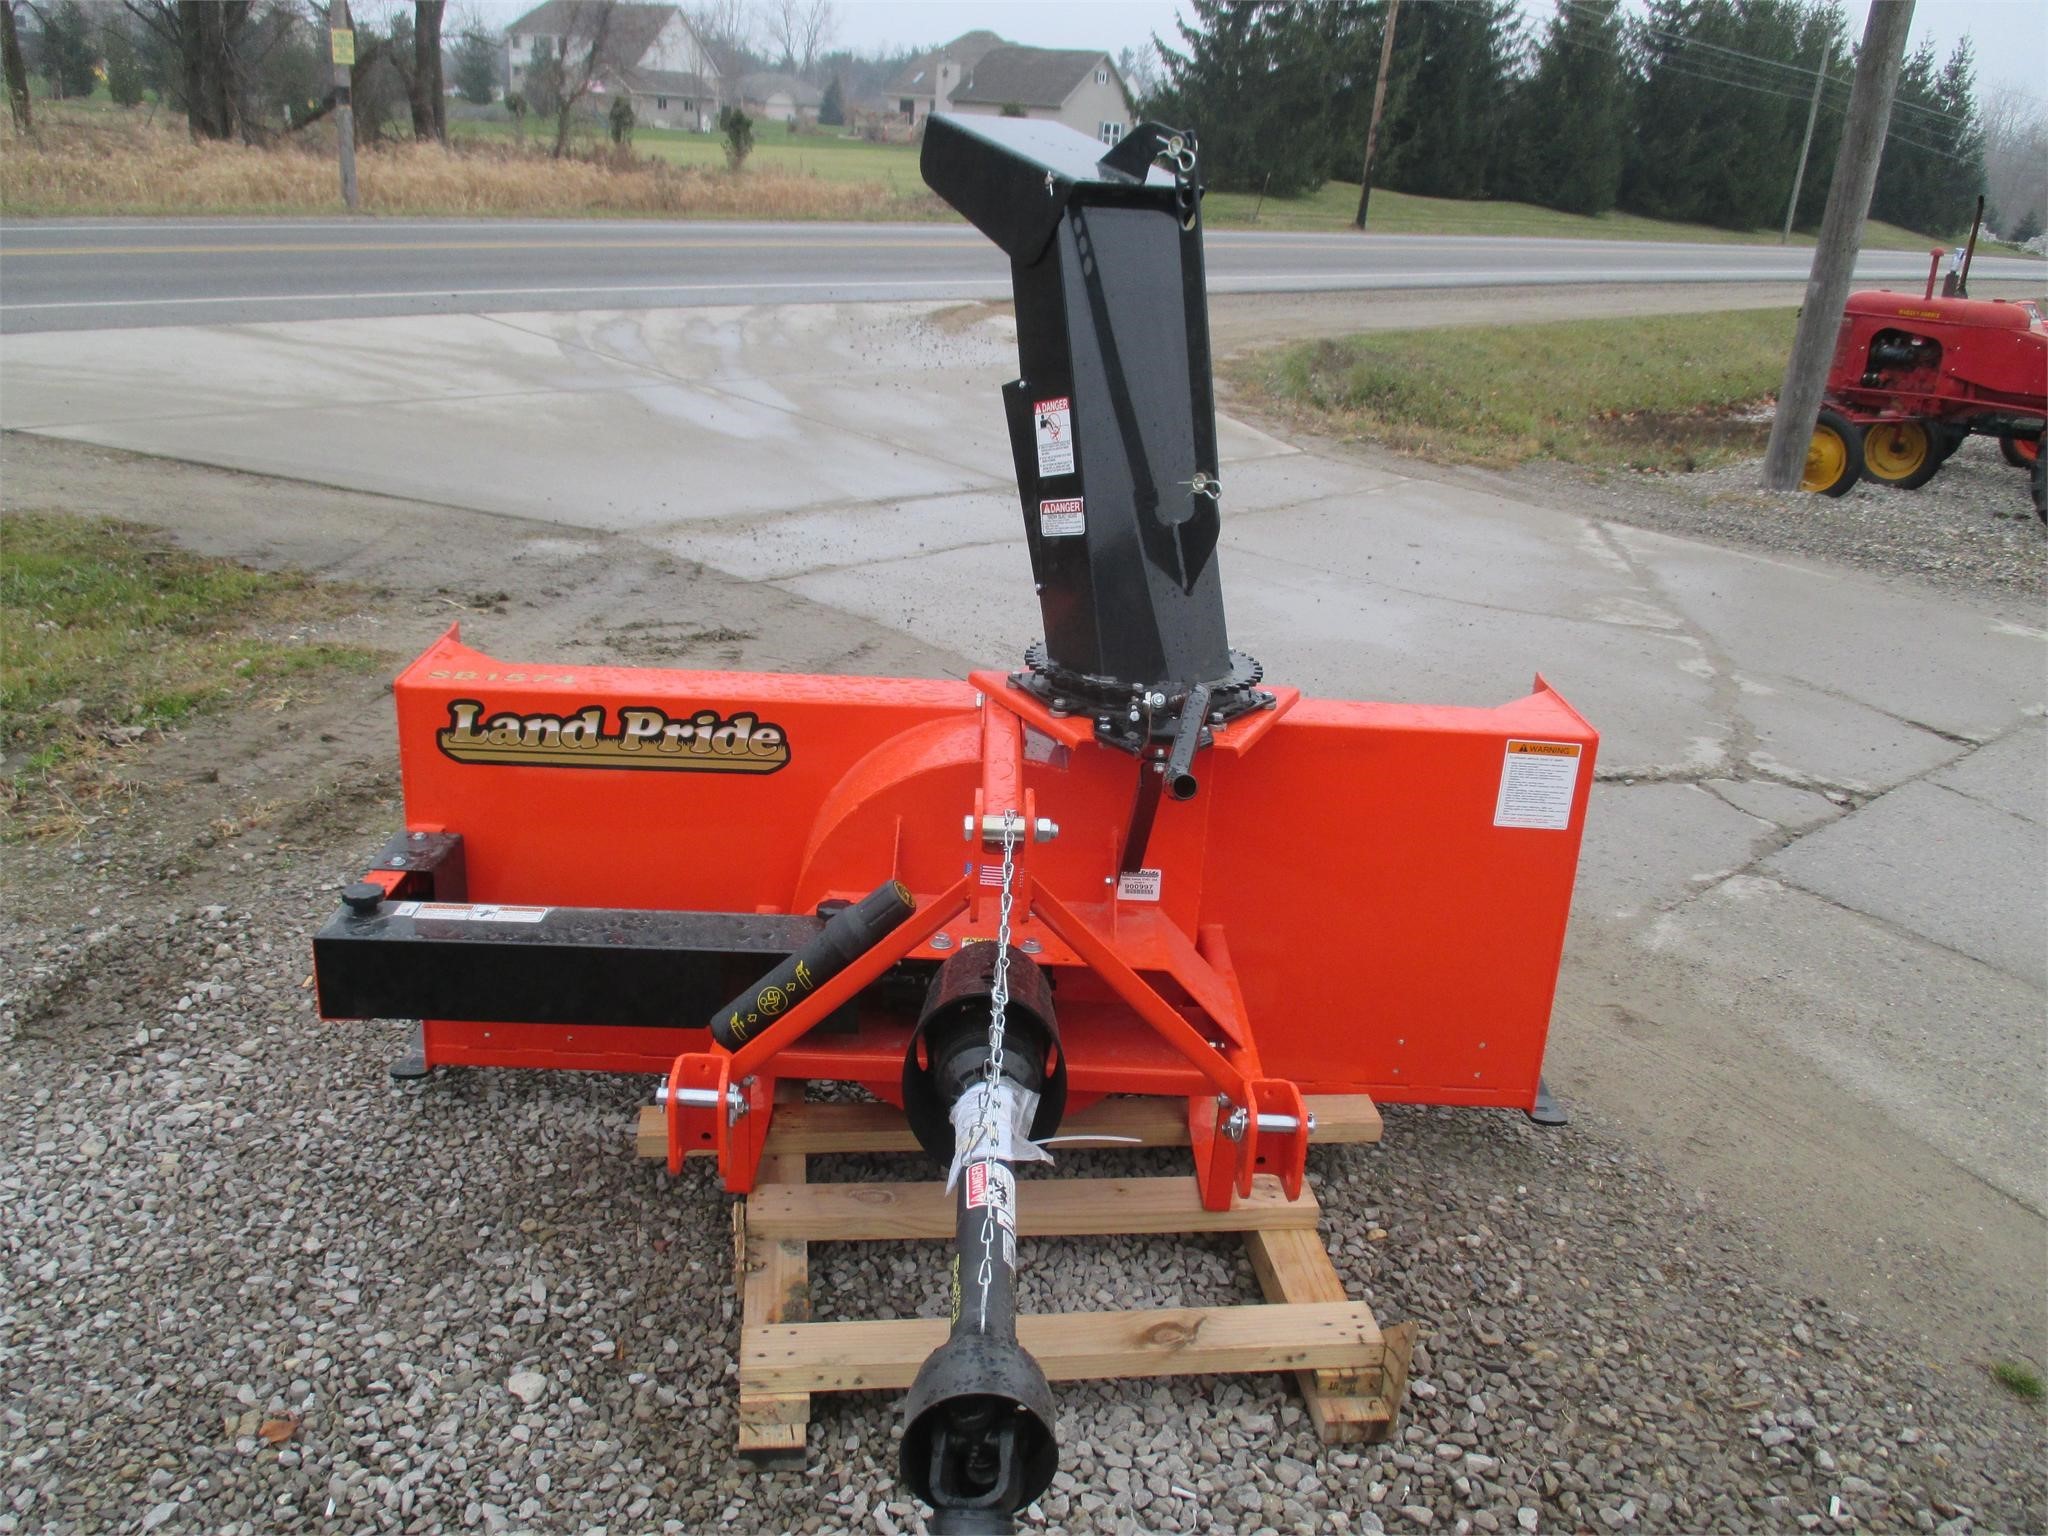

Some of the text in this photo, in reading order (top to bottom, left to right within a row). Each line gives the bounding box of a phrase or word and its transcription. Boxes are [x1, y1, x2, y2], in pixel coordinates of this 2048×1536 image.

[1041, 399, 1068, 413] DANGER
[1050, 501, 1081, 513] DANGER
[448, 702, 783, 757] Land Pride
[1529, 745, 1569, 755] WARNING
[971, 1165, 984, 1195] DANGER
